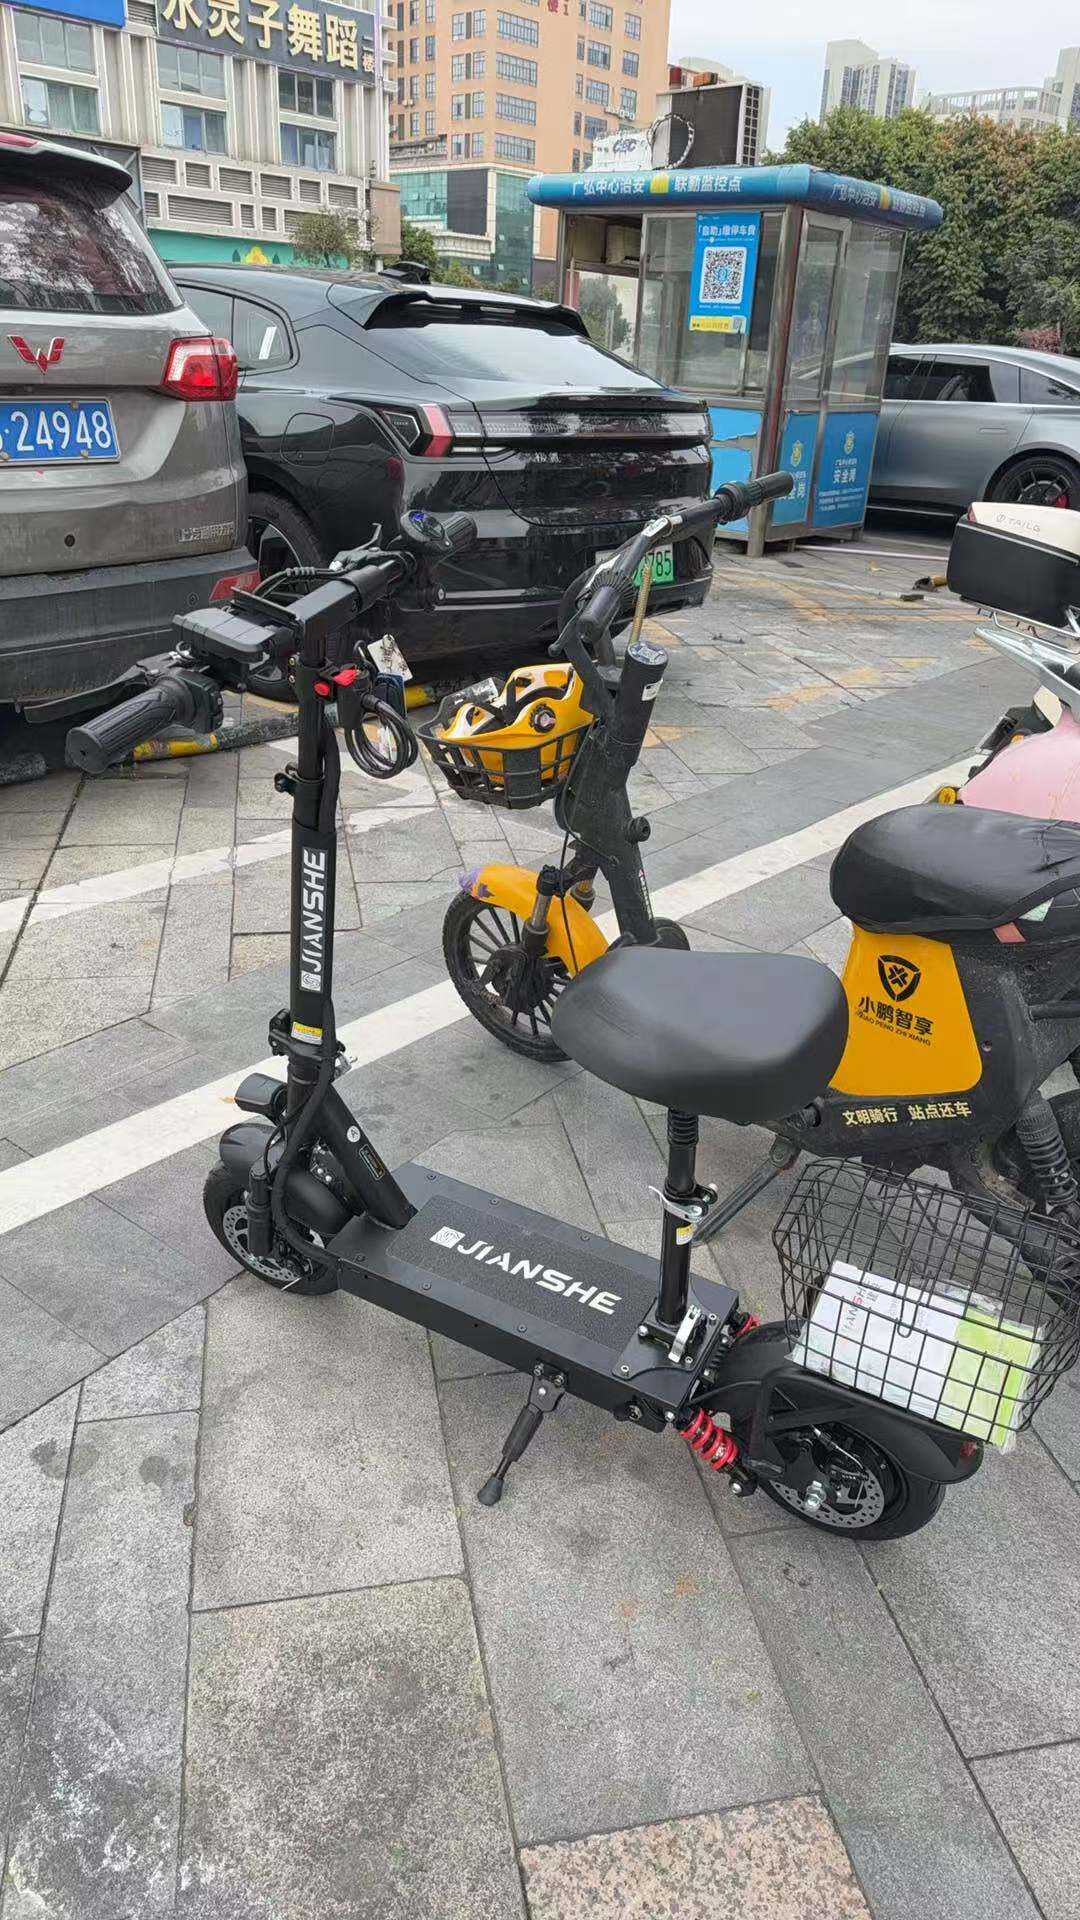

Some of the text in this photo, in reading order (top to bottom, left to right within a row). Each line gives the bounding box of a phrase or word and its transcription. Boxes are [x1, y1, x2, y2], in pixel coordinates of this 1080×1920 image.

[162, 0, 358, 70] 水灵子舞蹈
[572, 174, 743, 195] 广弘中心治安 联勤监控点
[0, 411, 112, 451] ·24948
[1008, 517, 1041, 533] TAILG
[302, 850, 326, 973] JIANSHE
[858, 996, 934, 1035] 小鹏智享
[875, 1019, 894, 1032] PENG
[908, 1032, 931, 1046] XIANG
[842, 1101, 972, 1125] 文明骑行 站点还车
[457, 1240, 622, 1315] JIANSHE
